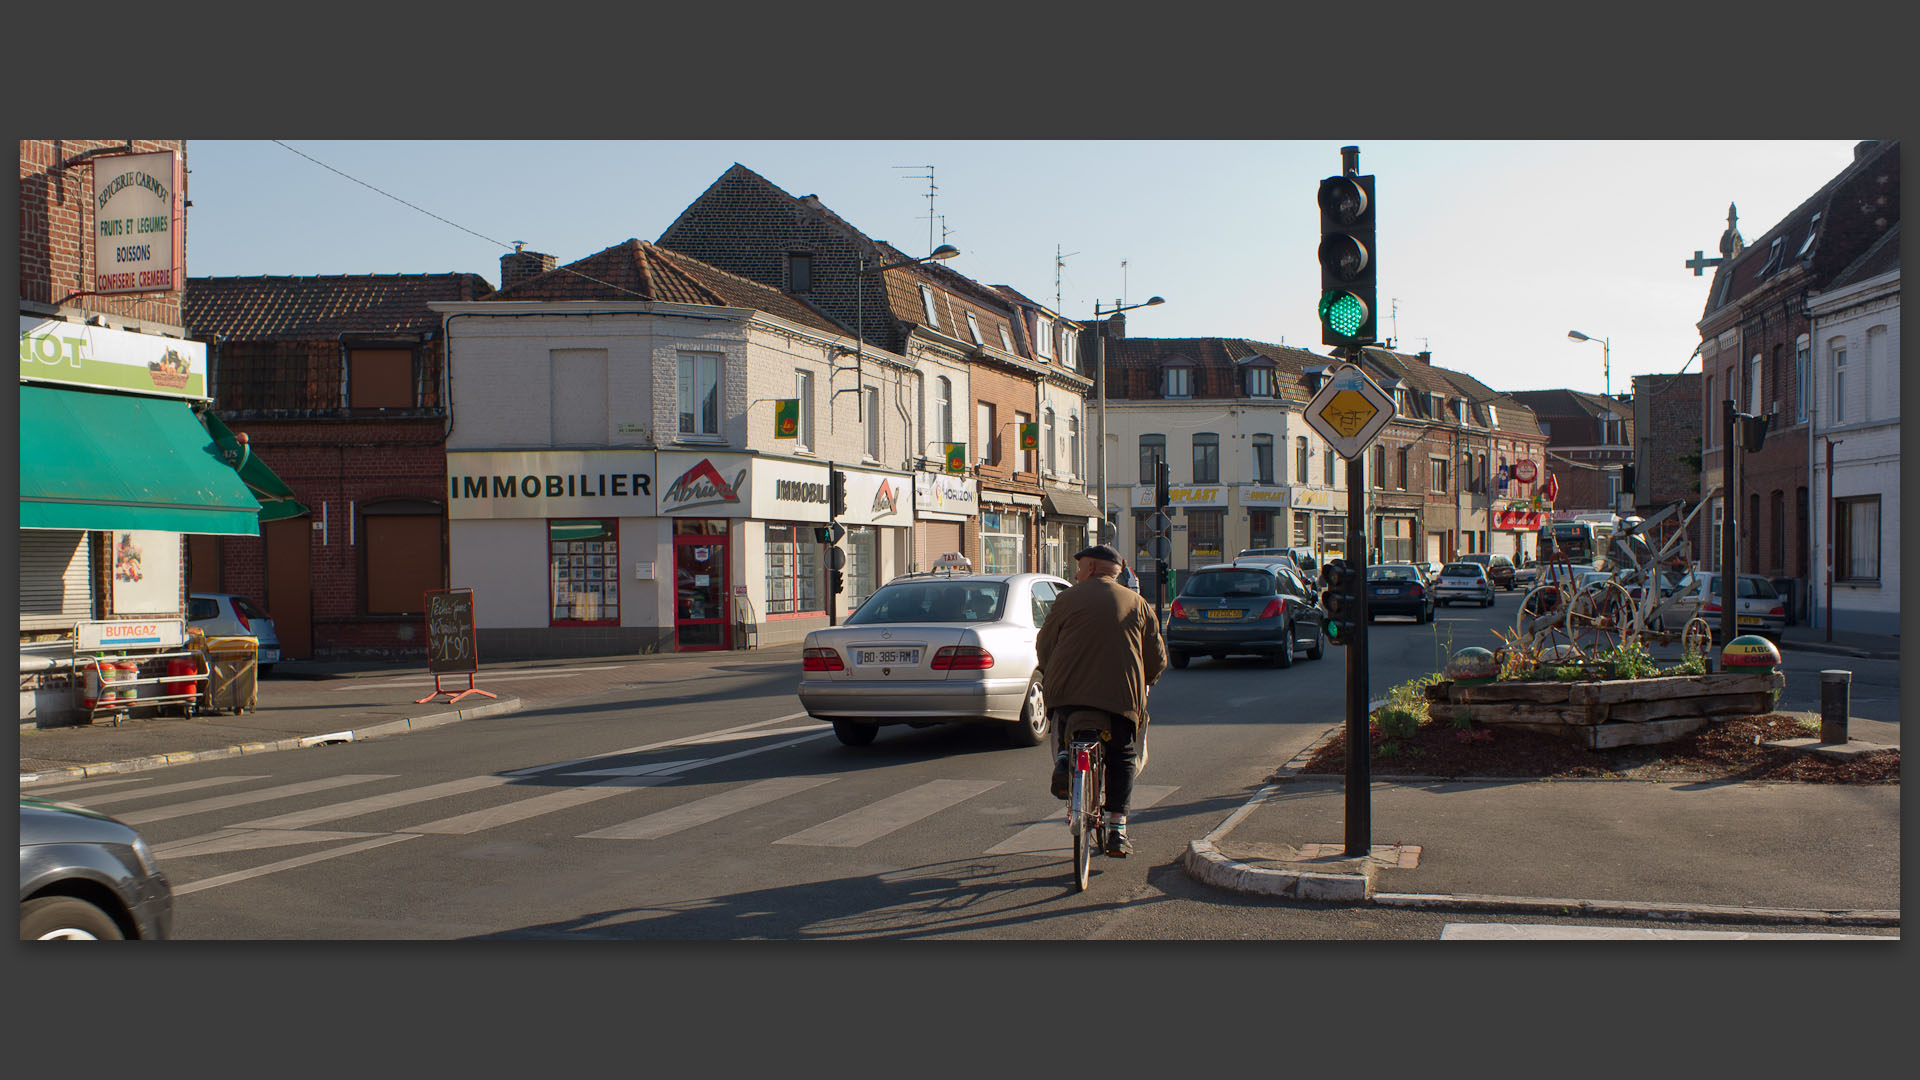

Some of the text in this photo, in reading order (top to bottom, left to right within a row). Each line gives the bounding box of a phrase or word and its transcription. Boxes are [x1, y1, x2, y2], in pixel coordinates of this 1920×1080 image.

[98, 171, 169, 209] EPICERIE CARNOT
[100, 215, 168, 237] FRUITS ET LEGUMES
[116, 244, 151, 263] BOISSONS
[97, 269, 170, 291] CONFISERIE CREMERIE
[451, 474, 651, 499] IMMOBILIER
[943, 554, 958, 562] TAXI
[105, 625, 157, 637] BUTAGAZ
